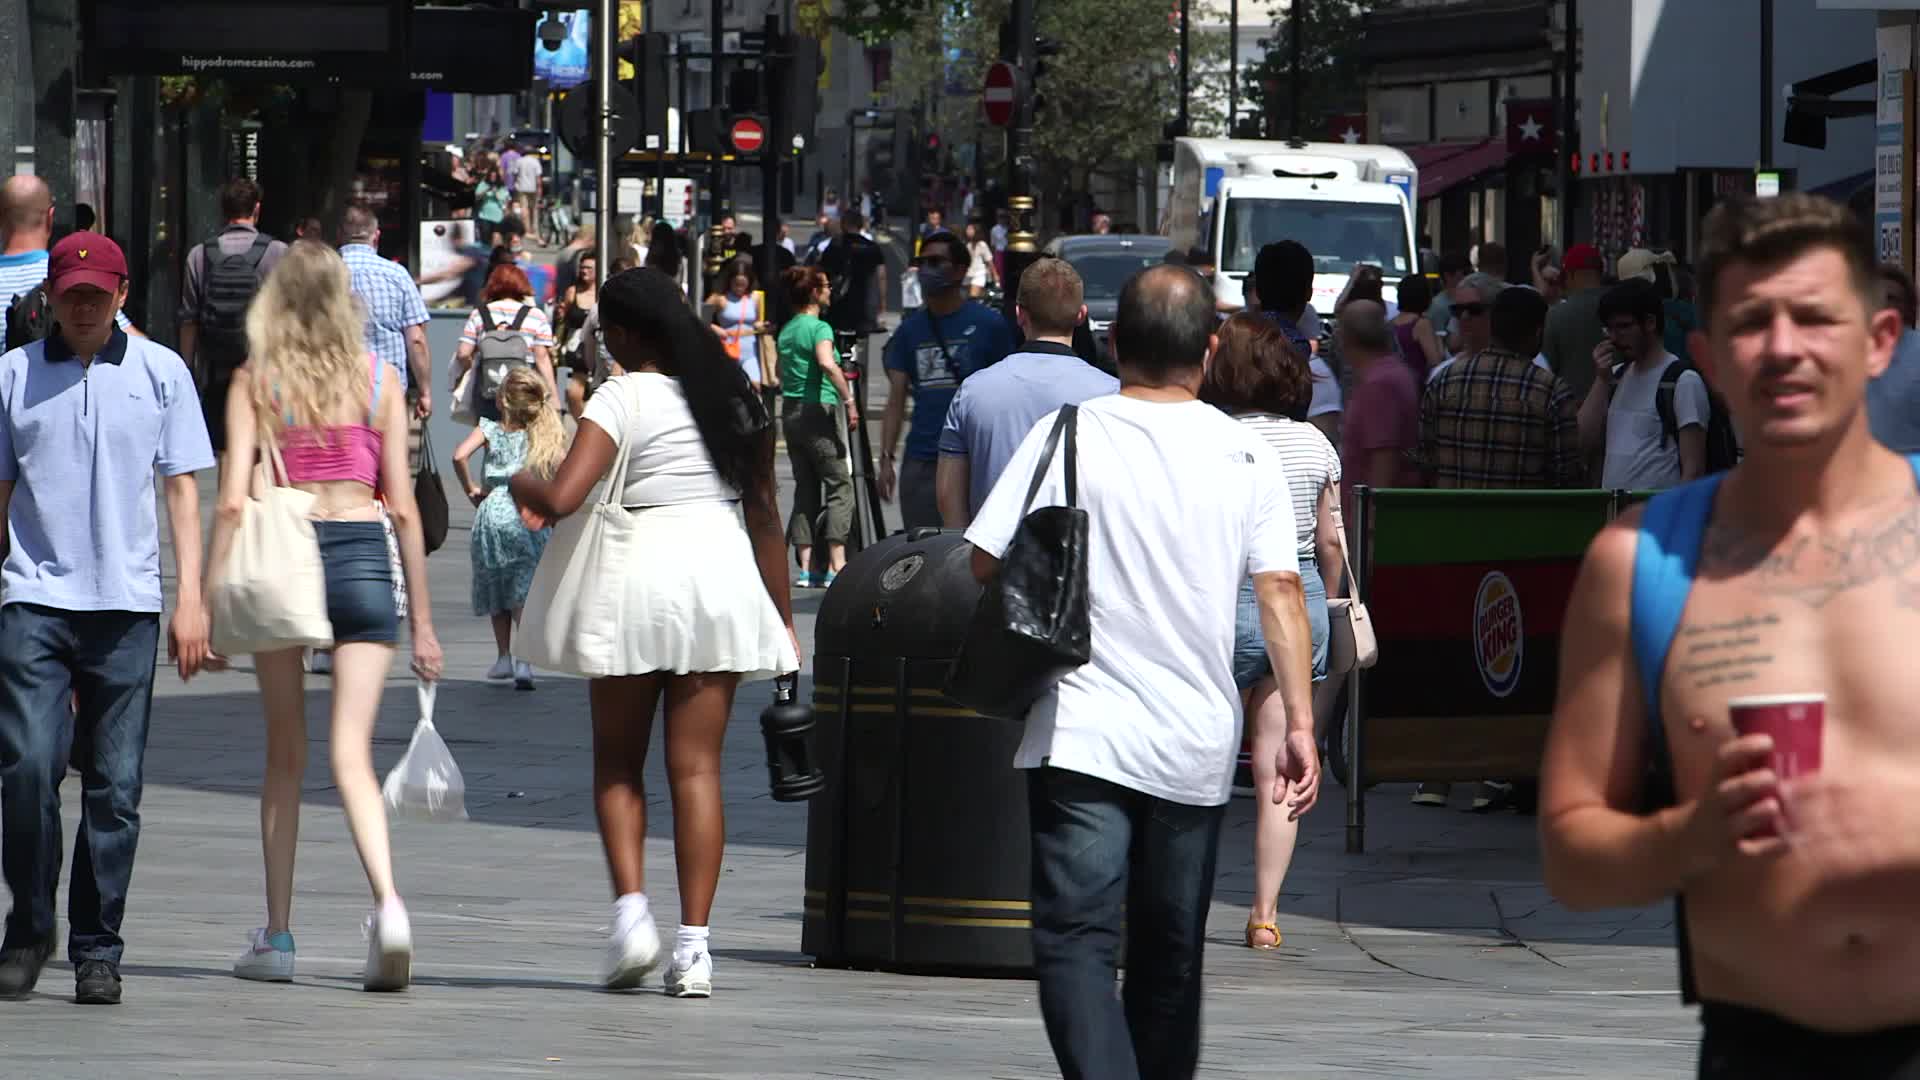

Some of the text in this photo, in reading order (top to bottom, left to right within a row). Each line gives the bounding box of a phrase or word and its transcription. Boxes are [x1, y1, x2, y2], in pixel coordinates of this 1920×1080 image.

[182, 55, 315, 71] hippodromecasino.com
[246, 132, 257, 158] THE
[1480, 594, 1514, 638] BURGER
[1483, 616, 1517, 666] KING
